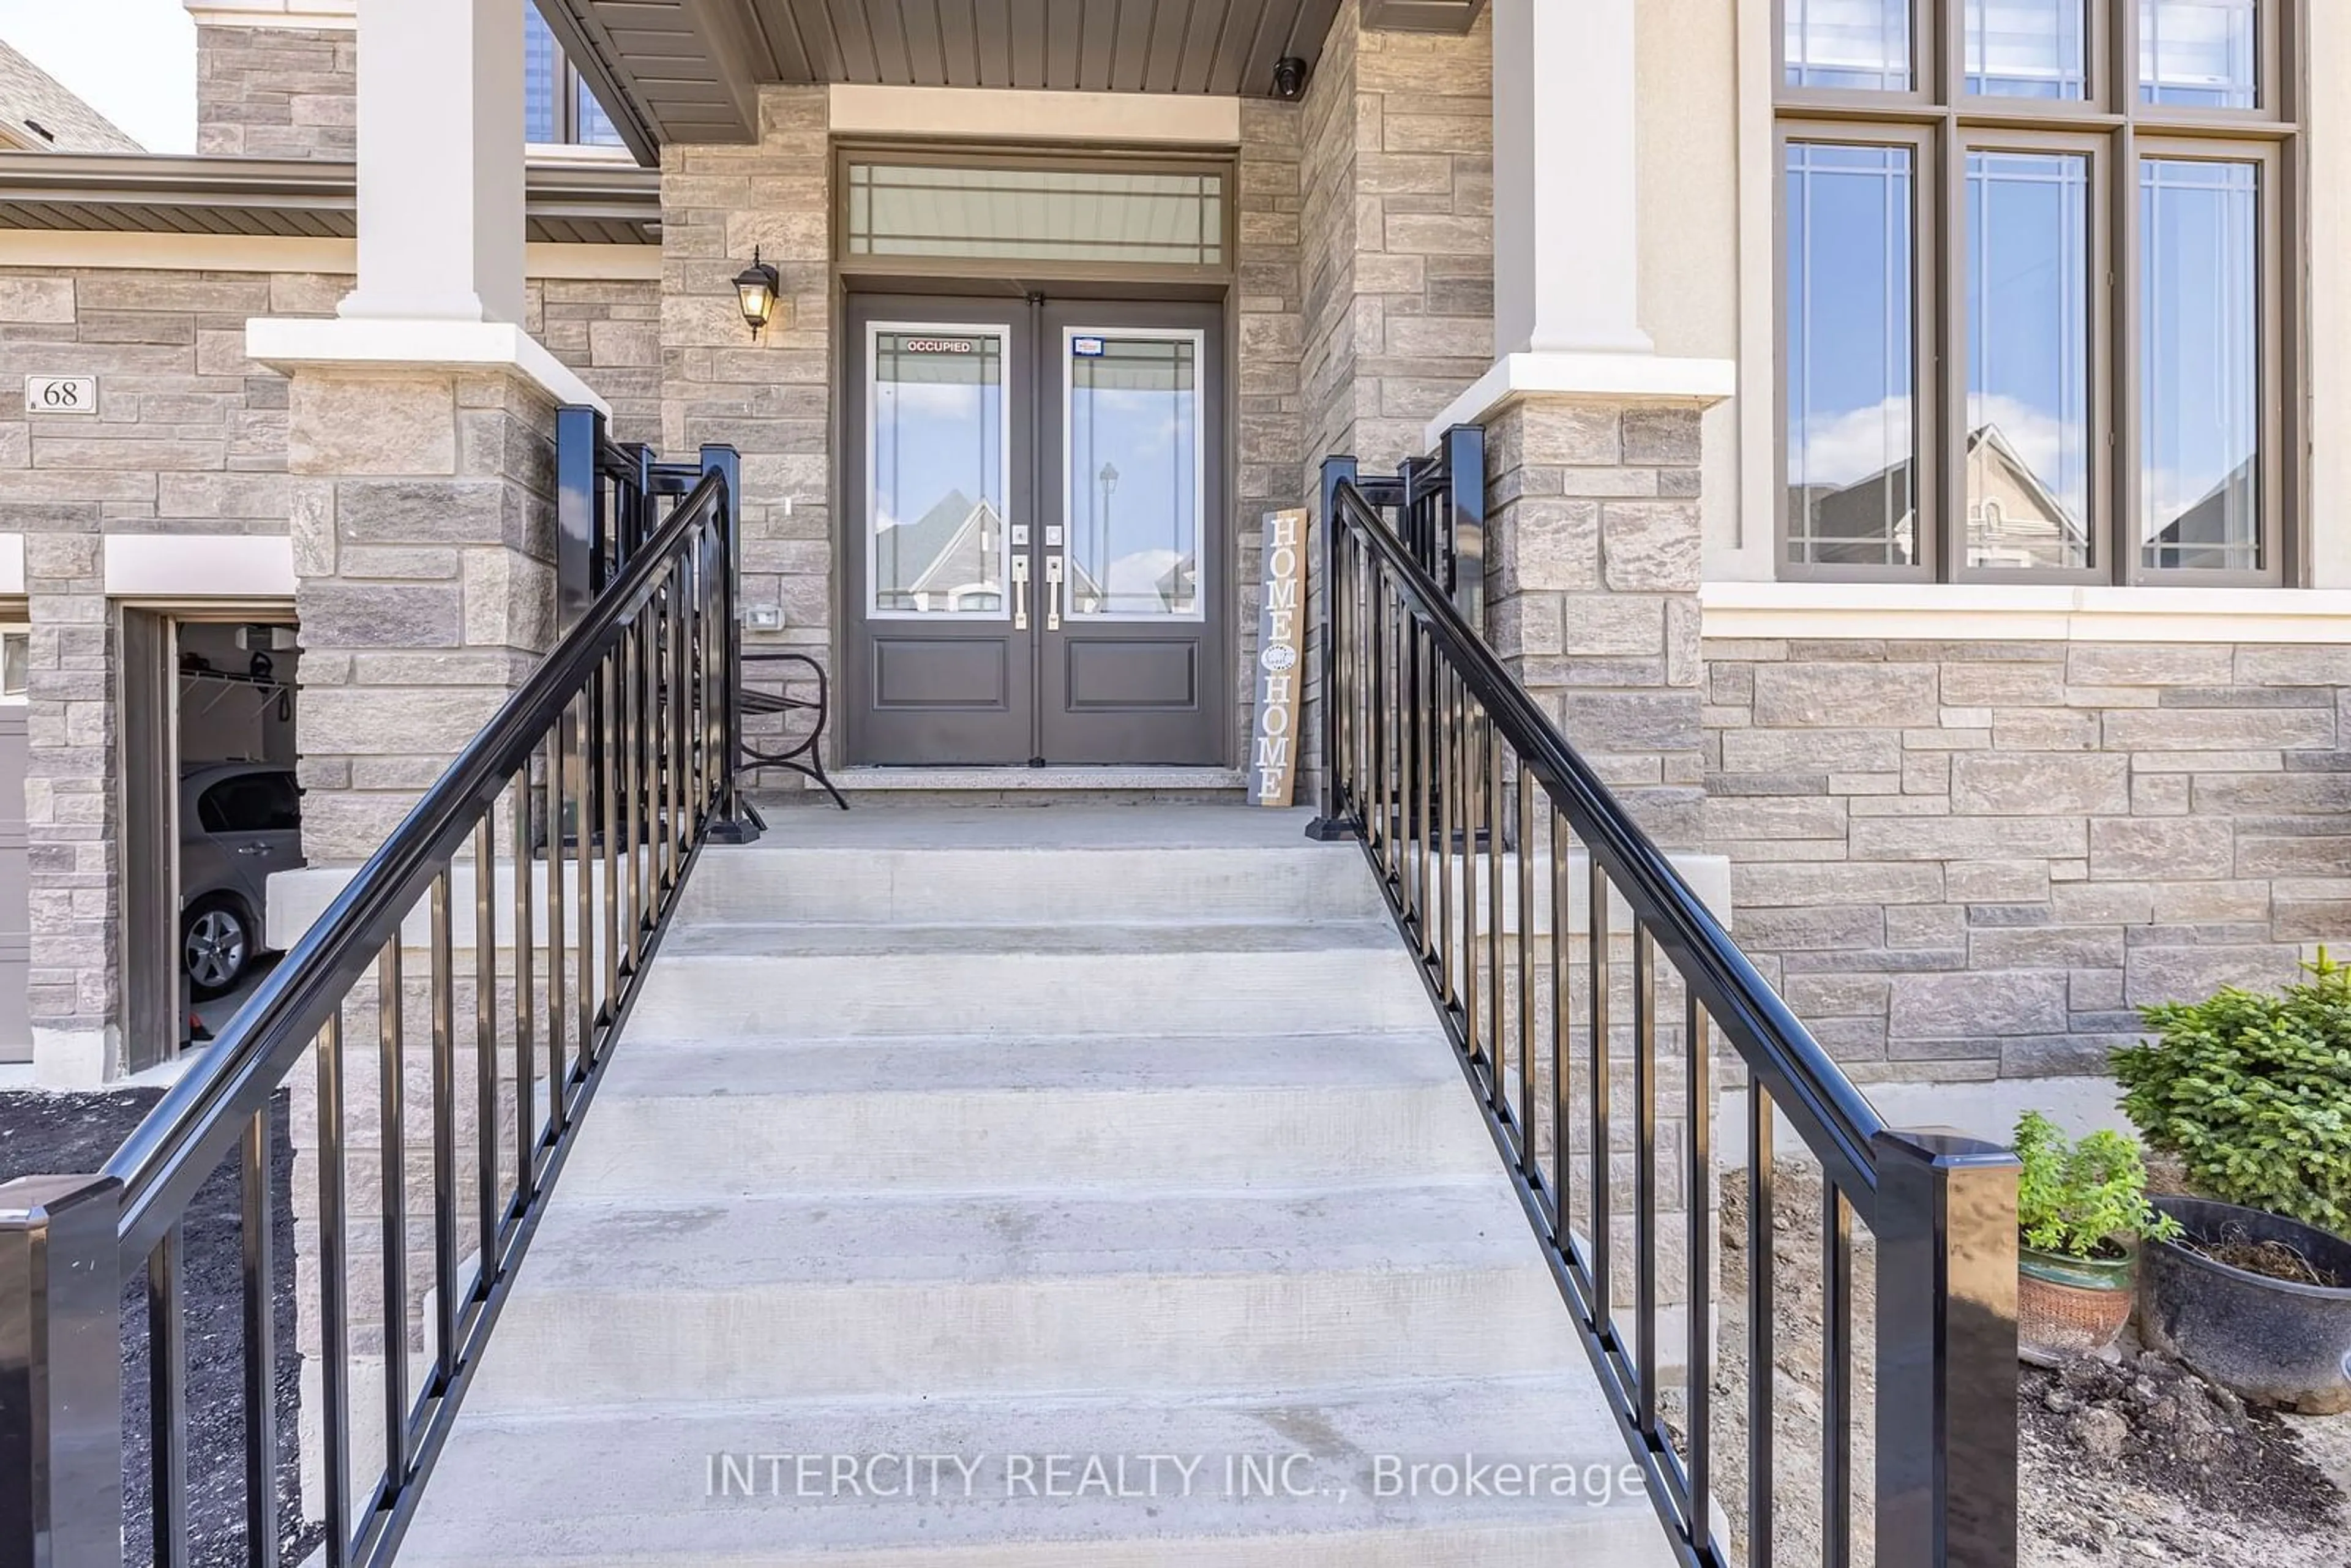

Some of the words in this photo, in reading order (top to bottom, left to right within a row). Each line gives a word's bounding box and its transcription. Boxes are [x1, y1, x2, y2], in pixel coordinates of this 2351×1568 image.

[907, 341, 970, 353] OCCUPIED
[43, 381, 78, 407] 68
[1265, 517, 1298, 641] HOME
[1256, 675, 1291, 799] HOME
